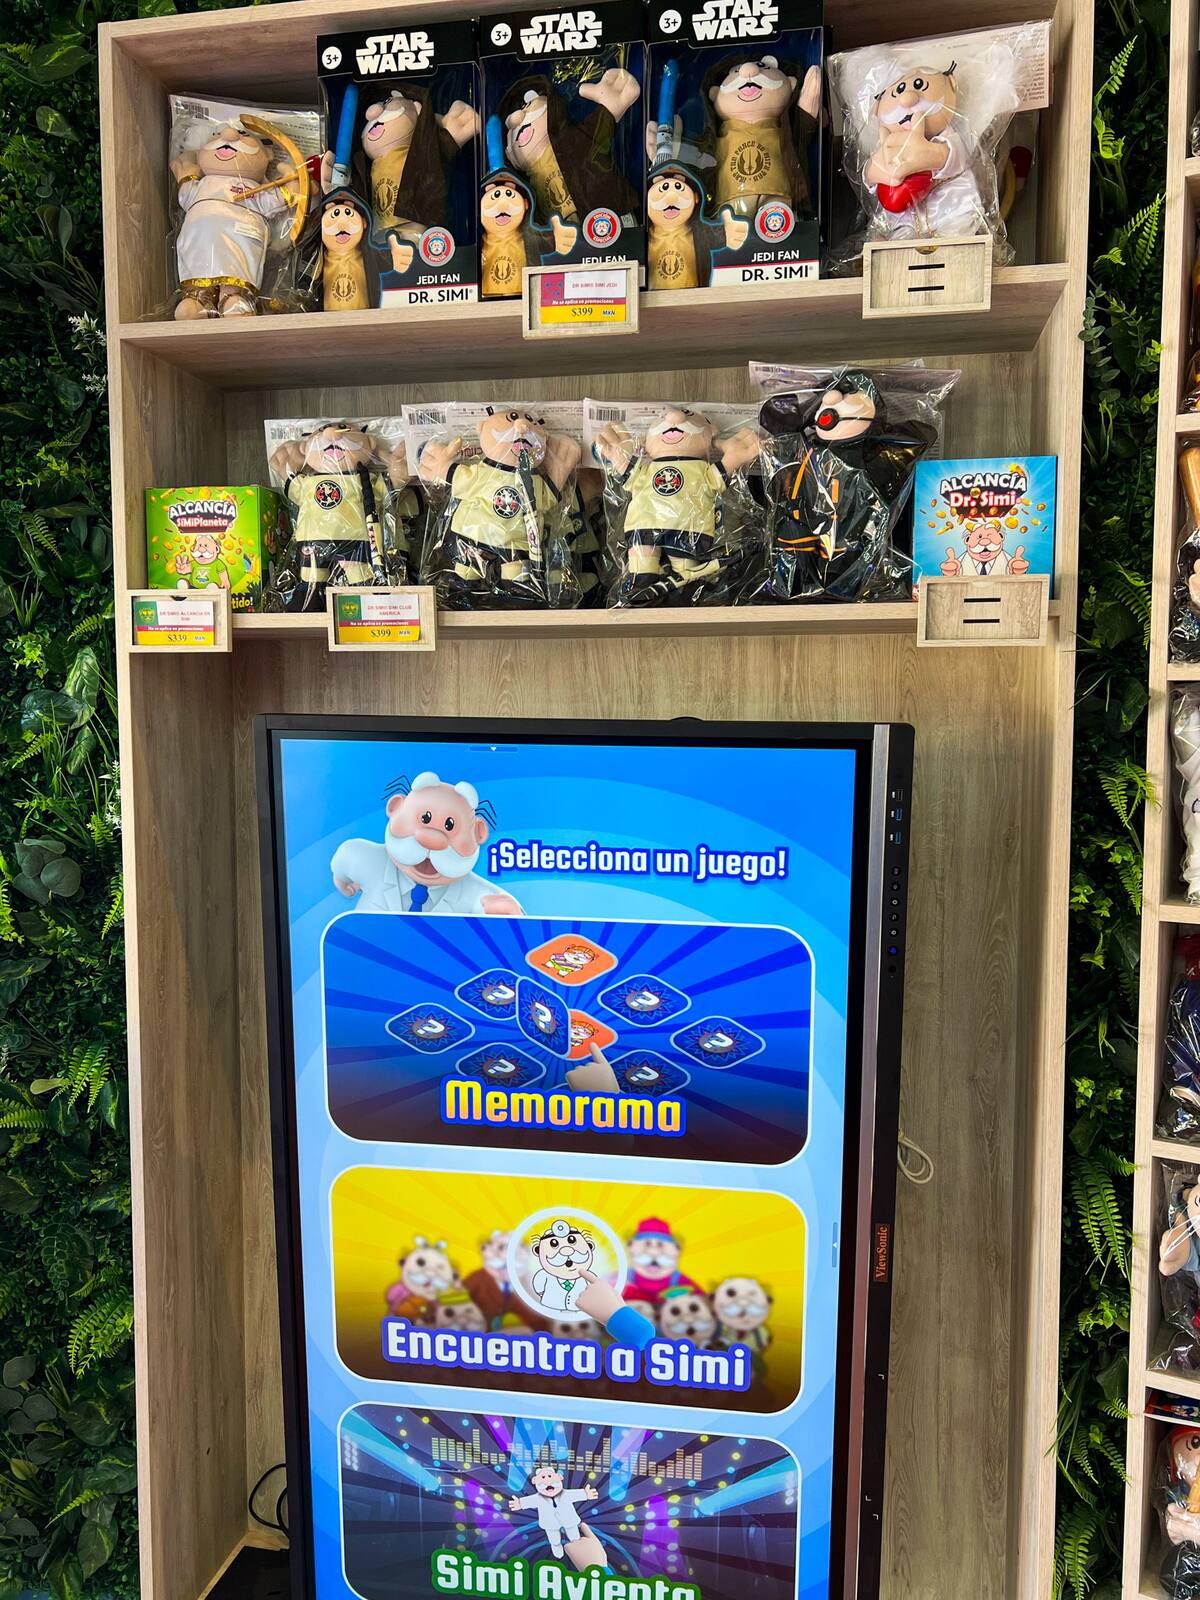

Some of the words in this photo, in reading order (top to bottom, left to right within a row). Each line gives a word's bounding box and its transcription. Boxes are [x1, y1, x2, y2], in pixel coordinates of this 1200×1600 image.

[692, 0, 778, 22] STAR
[520, 10, 602, 36] STAR
[664, 16, 678, 29] 3+
[692, 14, 778, 41] WARS
[356, 31, 434, 56] STAR
[495, 30, 509, 41] 3+
[520, 29, 602, 55] WARS
[325, 54, 339, 65] 3+
[356, 49, 434, 75] WARS
[751, 251, 775, 263] JEDI
[778, 249, 800, 261] FAN
[416, 275, 438, 285] JEDI
[440, 273, 460, 283] FAN
[742, 268, 769, 282] DR.
[408, 290, 434, 304] DR.
[571, 307, 593, 316] $399
[940, 472, 1028, 494] ALCANCÍA
[169, 500, 237, 518] ALCANCÍA
[950, 491, 978, 507] Dr.
[979, 489, 1016, 507] Simi
[371, 629, 391, 637] $399
[490, 842, 648, 874] ¡Selecciona
[656, 850, 689, 873] un
[697, 847, 787, 882] juego!
[445, 1079, 681, 1132] Memorama
[876, 1225, 888, 1278] ViewSonic
[387, 1321, 596, 1375] Encuentra
[612, 1347, 636, 1377] a
[650, 1342, 745, 1387] Simi
[436, 1554, 524, 1596] Simi
